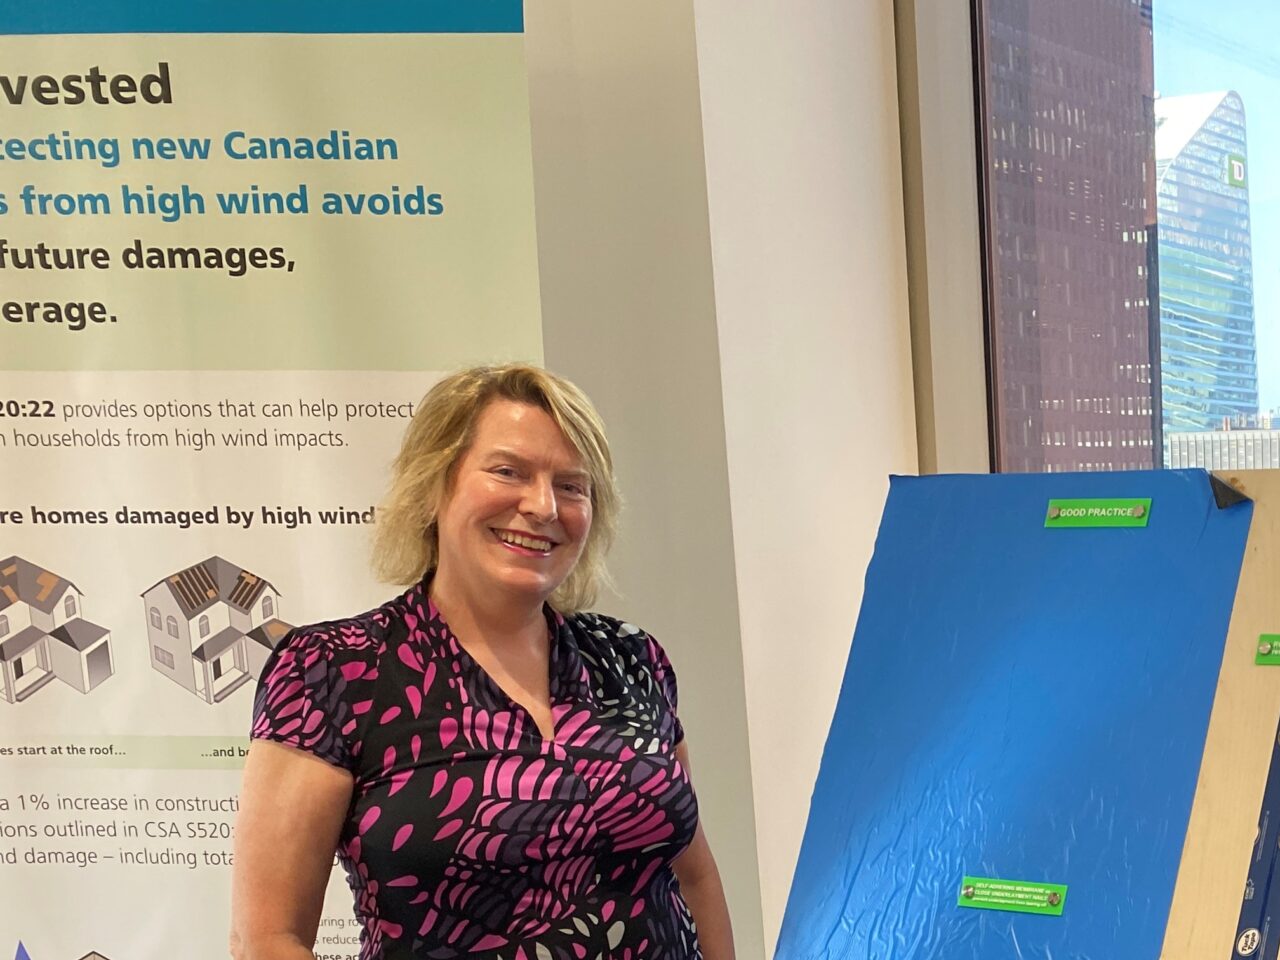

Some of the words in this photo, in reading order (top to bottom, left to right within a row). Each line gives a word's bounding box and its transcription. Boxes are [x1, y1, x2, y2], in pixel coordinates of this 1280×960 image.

[0, 62, 173, 105] vested
[133, 138, 211, 160] new
[224, 130, 399, 160] Canadian
[0, 240, 110, 269] future
[122, 240, 296, 276] damages,
[2, 300, 118, 330] erage.
[63, 401, 138, 420] provides
[143, 400, 212, 420] options
[219, 399, 256, 417] that
[262, 403, 293, 417] can
[299, 399, 338, 420] help
[345, 400, 414, 420] protect
[31, 507, 108, 524] homes
[115, 507, 219, 527] damaged
[226, 507, 254, 528] by
[261, 507, 312, 527] high
[318, 507, 376, 524] wind
[1060, 508, 1086, 516] GOOD
[1088, 508, 1133, 516] PRACTICE
[17, 746, 47, 755] start
[51, 746, 63, 755] at
[66, 745, 86, 755] the
[89, 744, 126, 755] roof...
[18, 796, 50, 810] 1%
[57, 795, 128, 811] increase
[133, 795, 149, 811] in
[43, 821, 117, 838] outlined
[122, 822, 138, 838] in
[144, 822, 181, 838] CSA
[24, 849, 98, 867] damage
[120, 849, 197, 869] including
[1241, 934, 1250, 952] Tuck
[1248, 932, 1257, 950] Tape
